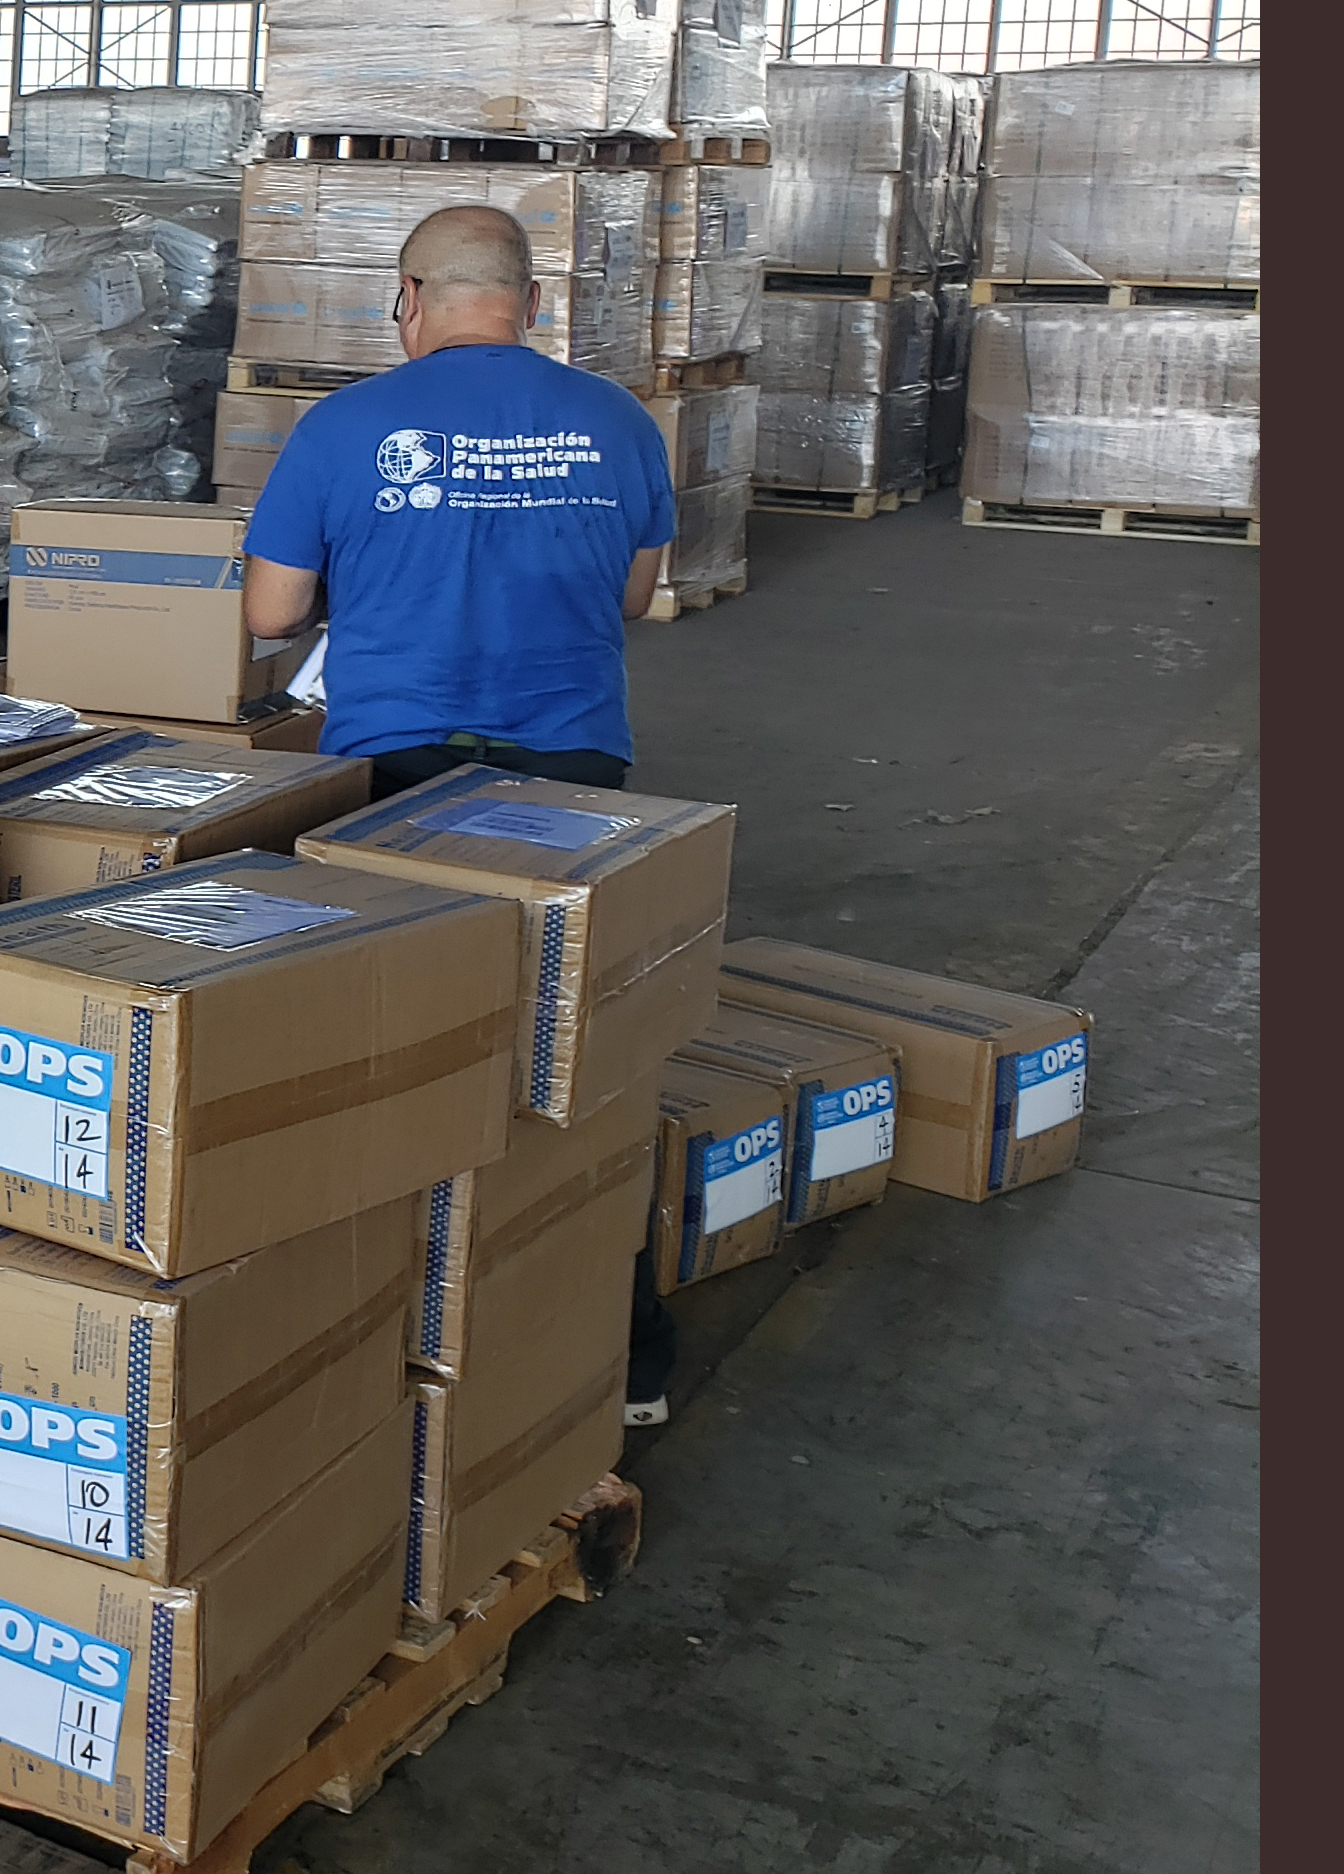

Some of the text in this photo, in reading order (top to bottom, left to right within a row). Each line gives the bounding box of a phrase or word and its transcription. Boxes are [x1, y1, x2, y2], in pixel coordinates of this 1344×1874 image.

[452, 432, 591, 452] Organización
[452, 448, 600, 465] Panamericana
[451, 463, 569, 480] de la Salud
[448, 499, 518, 509] Organización
[522, 498, 564, 508] Mundial
[1042, 1038, 1084, 1074] OPS
[843, 1080, 891, 1115] OPS
[64, 1115, 102, 1145] 12
[734, 1119, 780, 1162] OPS
[878, 1115, 889, 1136] 4
[64, 1153, 94, 1190] 14
[81, 1479, 110, 1509] 10
[85, 1517, 113, 1552] 14
[77, 1701, 97, 1735] 11
[70, 1733, 102, 1770] 14
